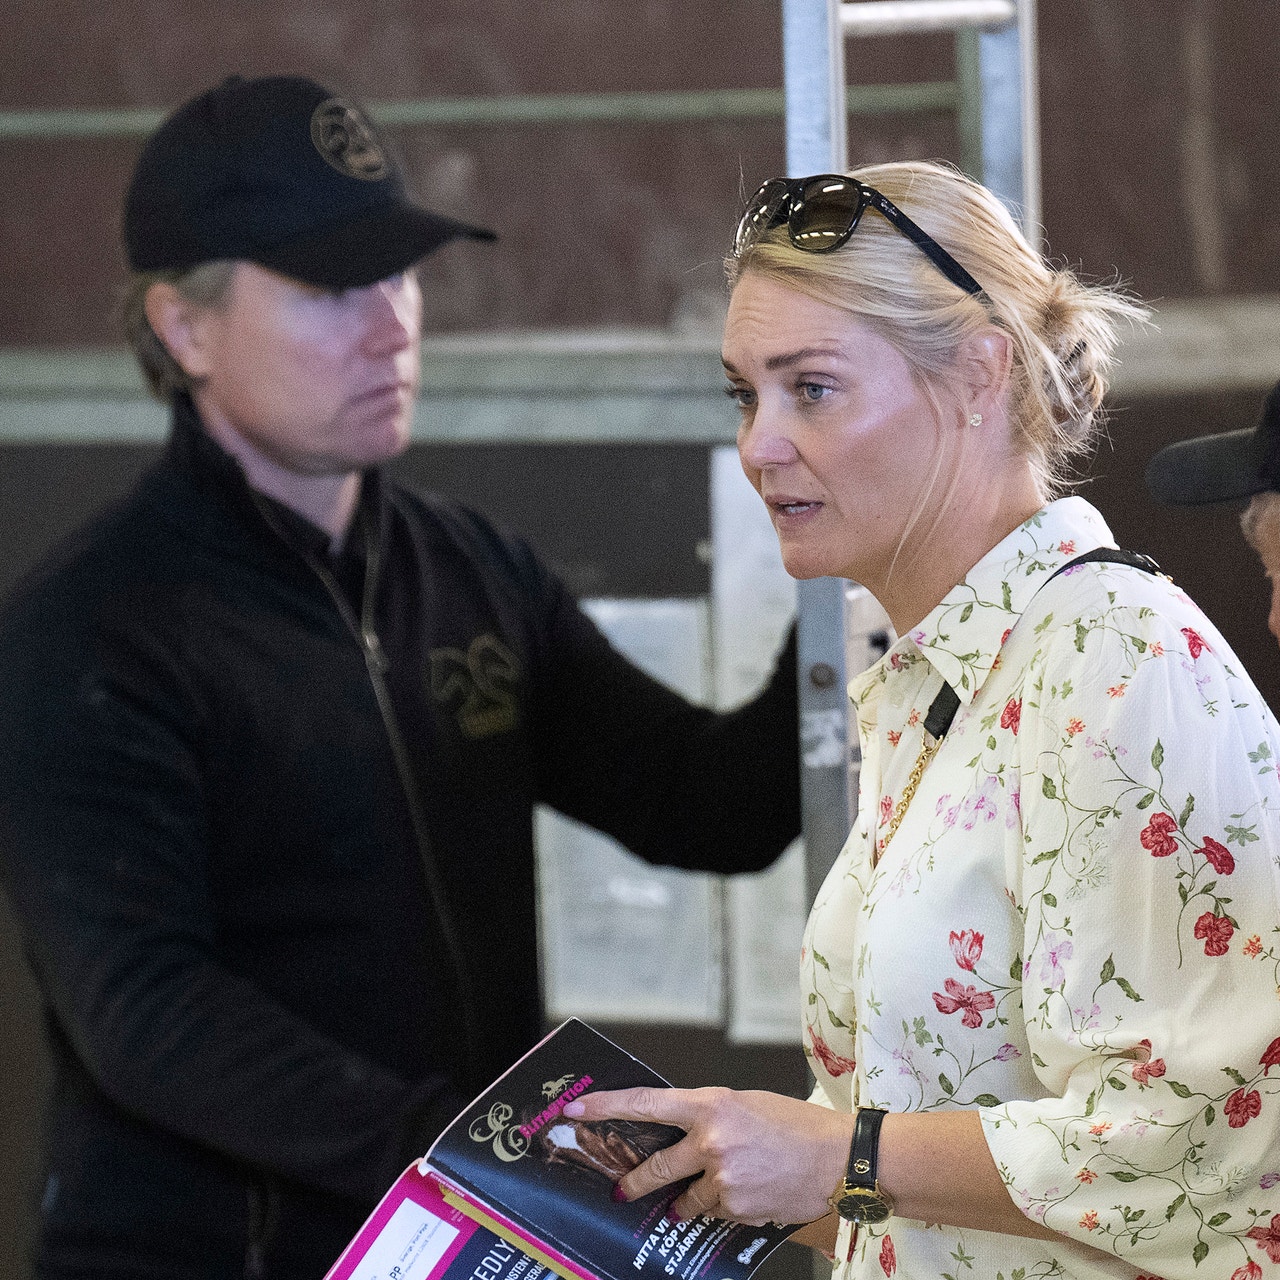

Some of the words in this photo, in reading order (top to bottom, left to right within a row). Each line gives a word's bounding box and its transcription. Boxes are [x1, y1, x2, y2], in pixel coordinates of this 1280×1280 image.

[518, 1074, 594, 1139] ELITAUKTION
[631, 1231, 661, 1270] HITTA
[656, 1227, 681, 1258] KÖP
[663, 1222, 705, 1276] STJÄRNA
[388, 1264, 404, 1280] PP
